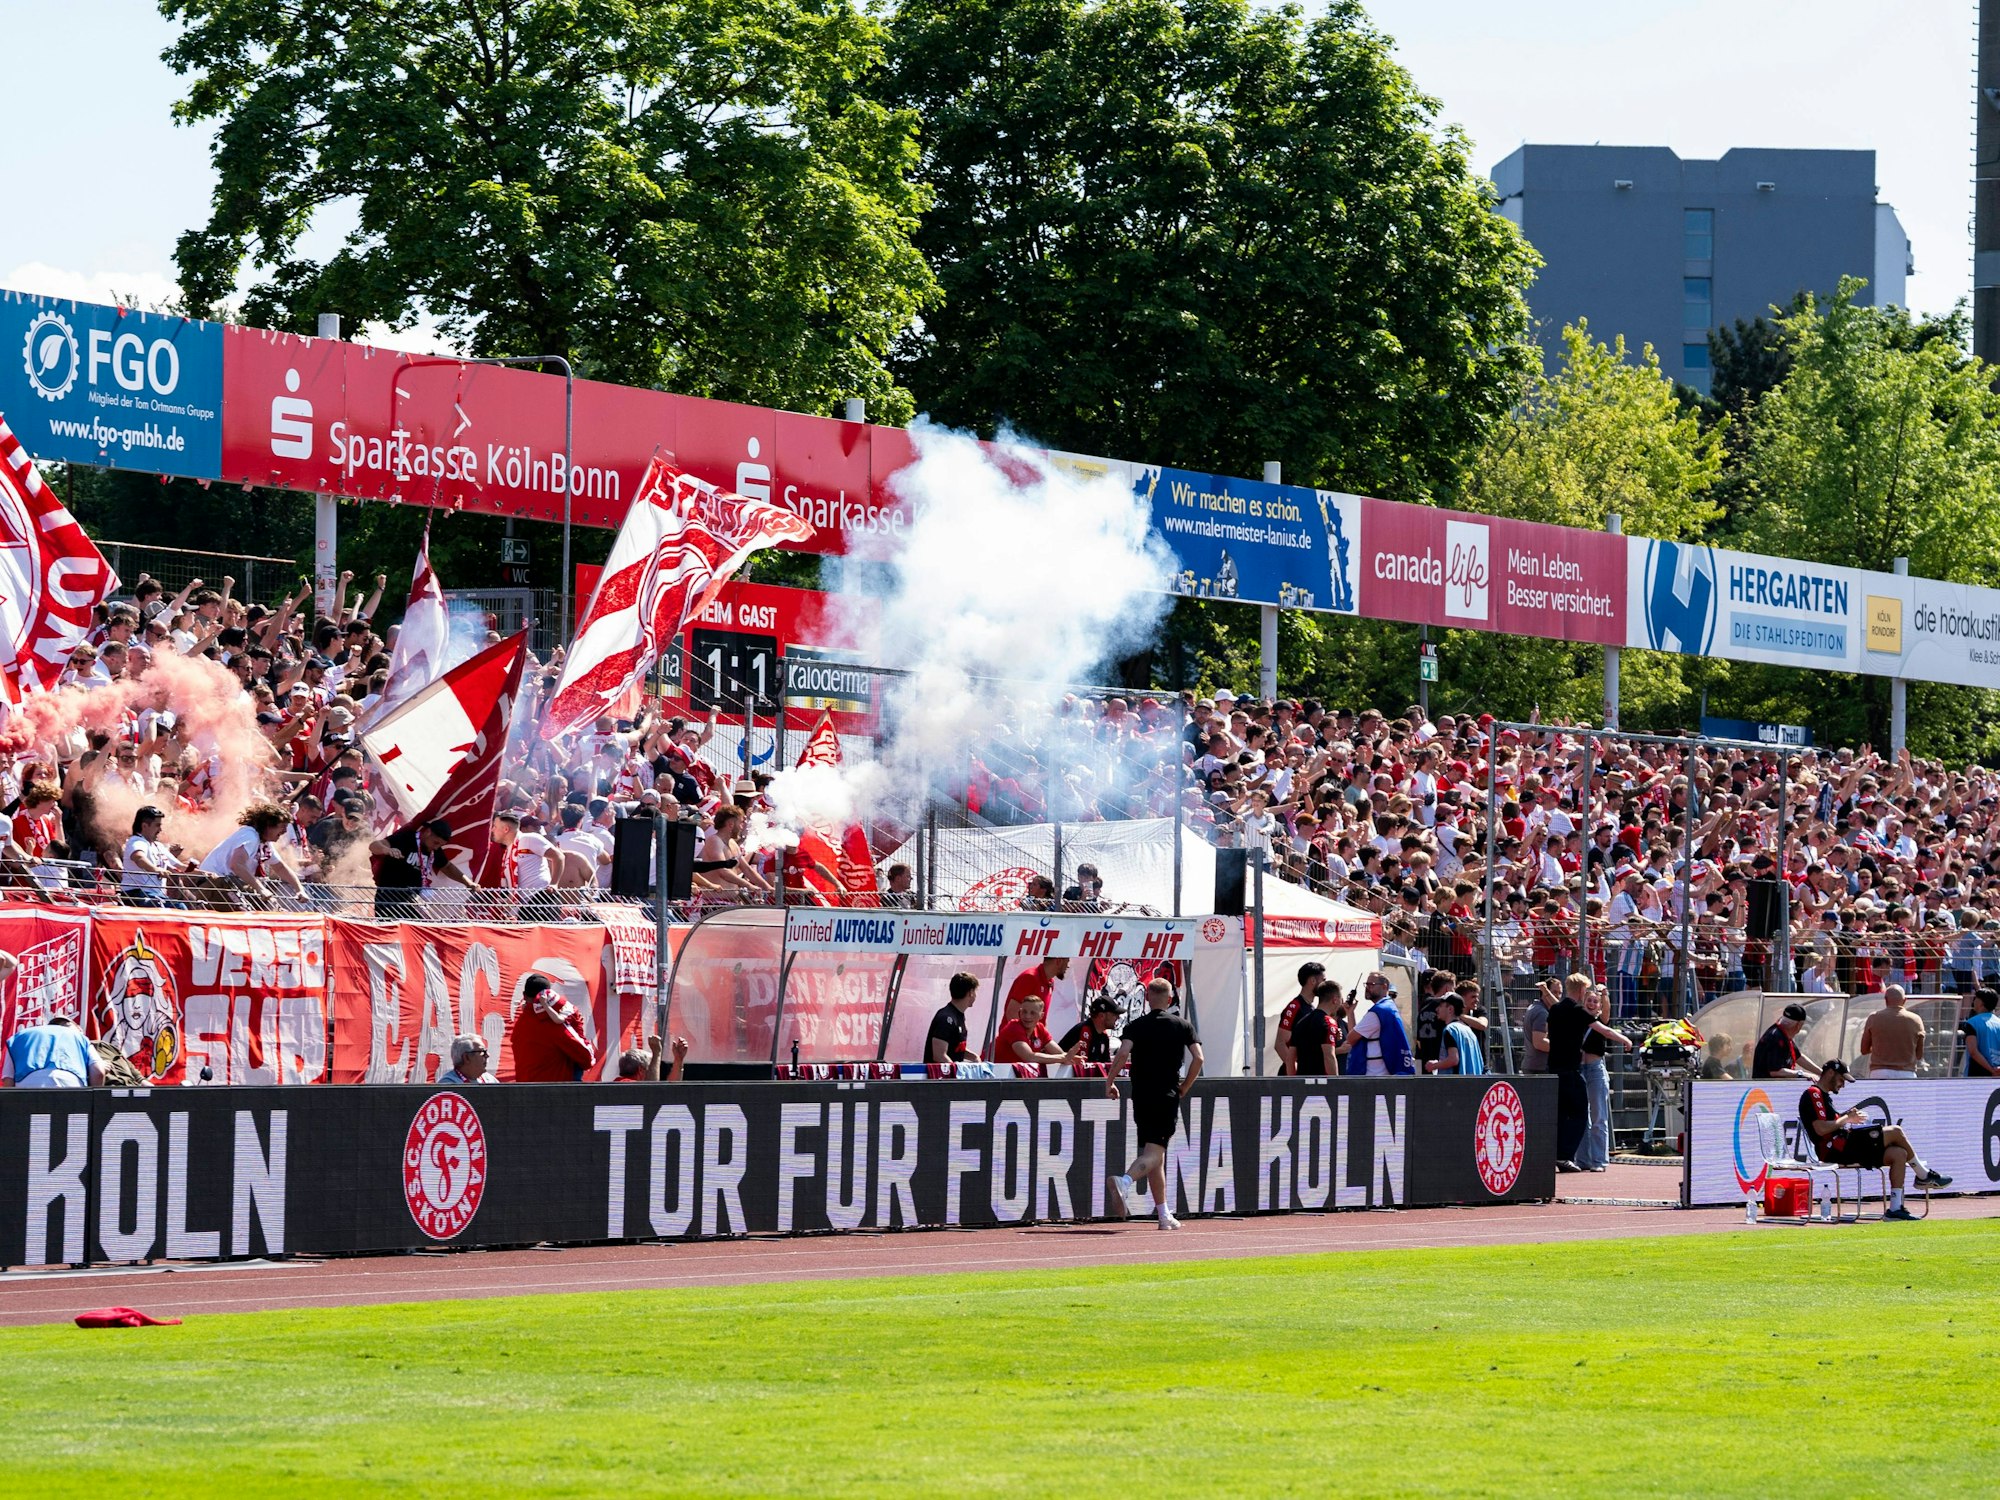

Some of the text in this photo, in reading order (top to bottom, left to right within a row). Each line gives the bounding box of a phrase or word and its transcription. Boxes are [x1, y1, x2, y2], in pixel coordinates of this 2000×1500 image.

[88, 328, 180, 395] FGO
[88, 391, 214, 421] Mitglied der Tom Ortmanns Gruppe
[50, 416, 185, 452] www.fgo-gmbh.de
[328, 421, 621, 501] Sparkasse KölnBonn
[784, 485, 904, 537] Sparkasse
[1171, 481, 1302, 522] Wir machen es schön.
[1165, 516, 1311, 549] www.malermeister-lanius.de
[513, 568, 530, 584] WC
[1375, 543, 1489, 608] canada life
[1508, 548, 1583, 582] Mein Leben.
[1508, 579, 1614, 617] Besser versichert.
[1730, 565, 1848, 615] HERGARTEN
[739, 604, 777, 629] GAST
[1871, 625, 1896, 638] RONDORF
[1877, 610, 1891, 623] KÖLN
[1914, 604, 1936, 633] die
[1427, 643, 1437, 656] WC
[1735, 622, 1843, 651] DIE STAHLSPEDITION
[1969, 648, 1983, 664] Klee
[1758, 724, 1800, 744] Gaffel Treff
[788, 915, 1185, 958] junited AUTOGLAS junited AUTOGLAS HIT HIT HIT
[1338, 918, 1371, 933] Duratent
[616, 945, 656, 969] VERBOT
[1482, 1086, 1523, 1154] FORTUNA
[415, 1099, 484, 1186] FORTUNA
[593, 1103, 749, 1239] TOR
[777, 1082, 919, 1232] FÜR
[1258, 1078, 1406, 1211] KÖLN
[25, 1089, 288, 1266] KÖLN
[1484, 1161, 1517, 1191] KÖLN
[419, 1194, 473, 1234] KÖLN
